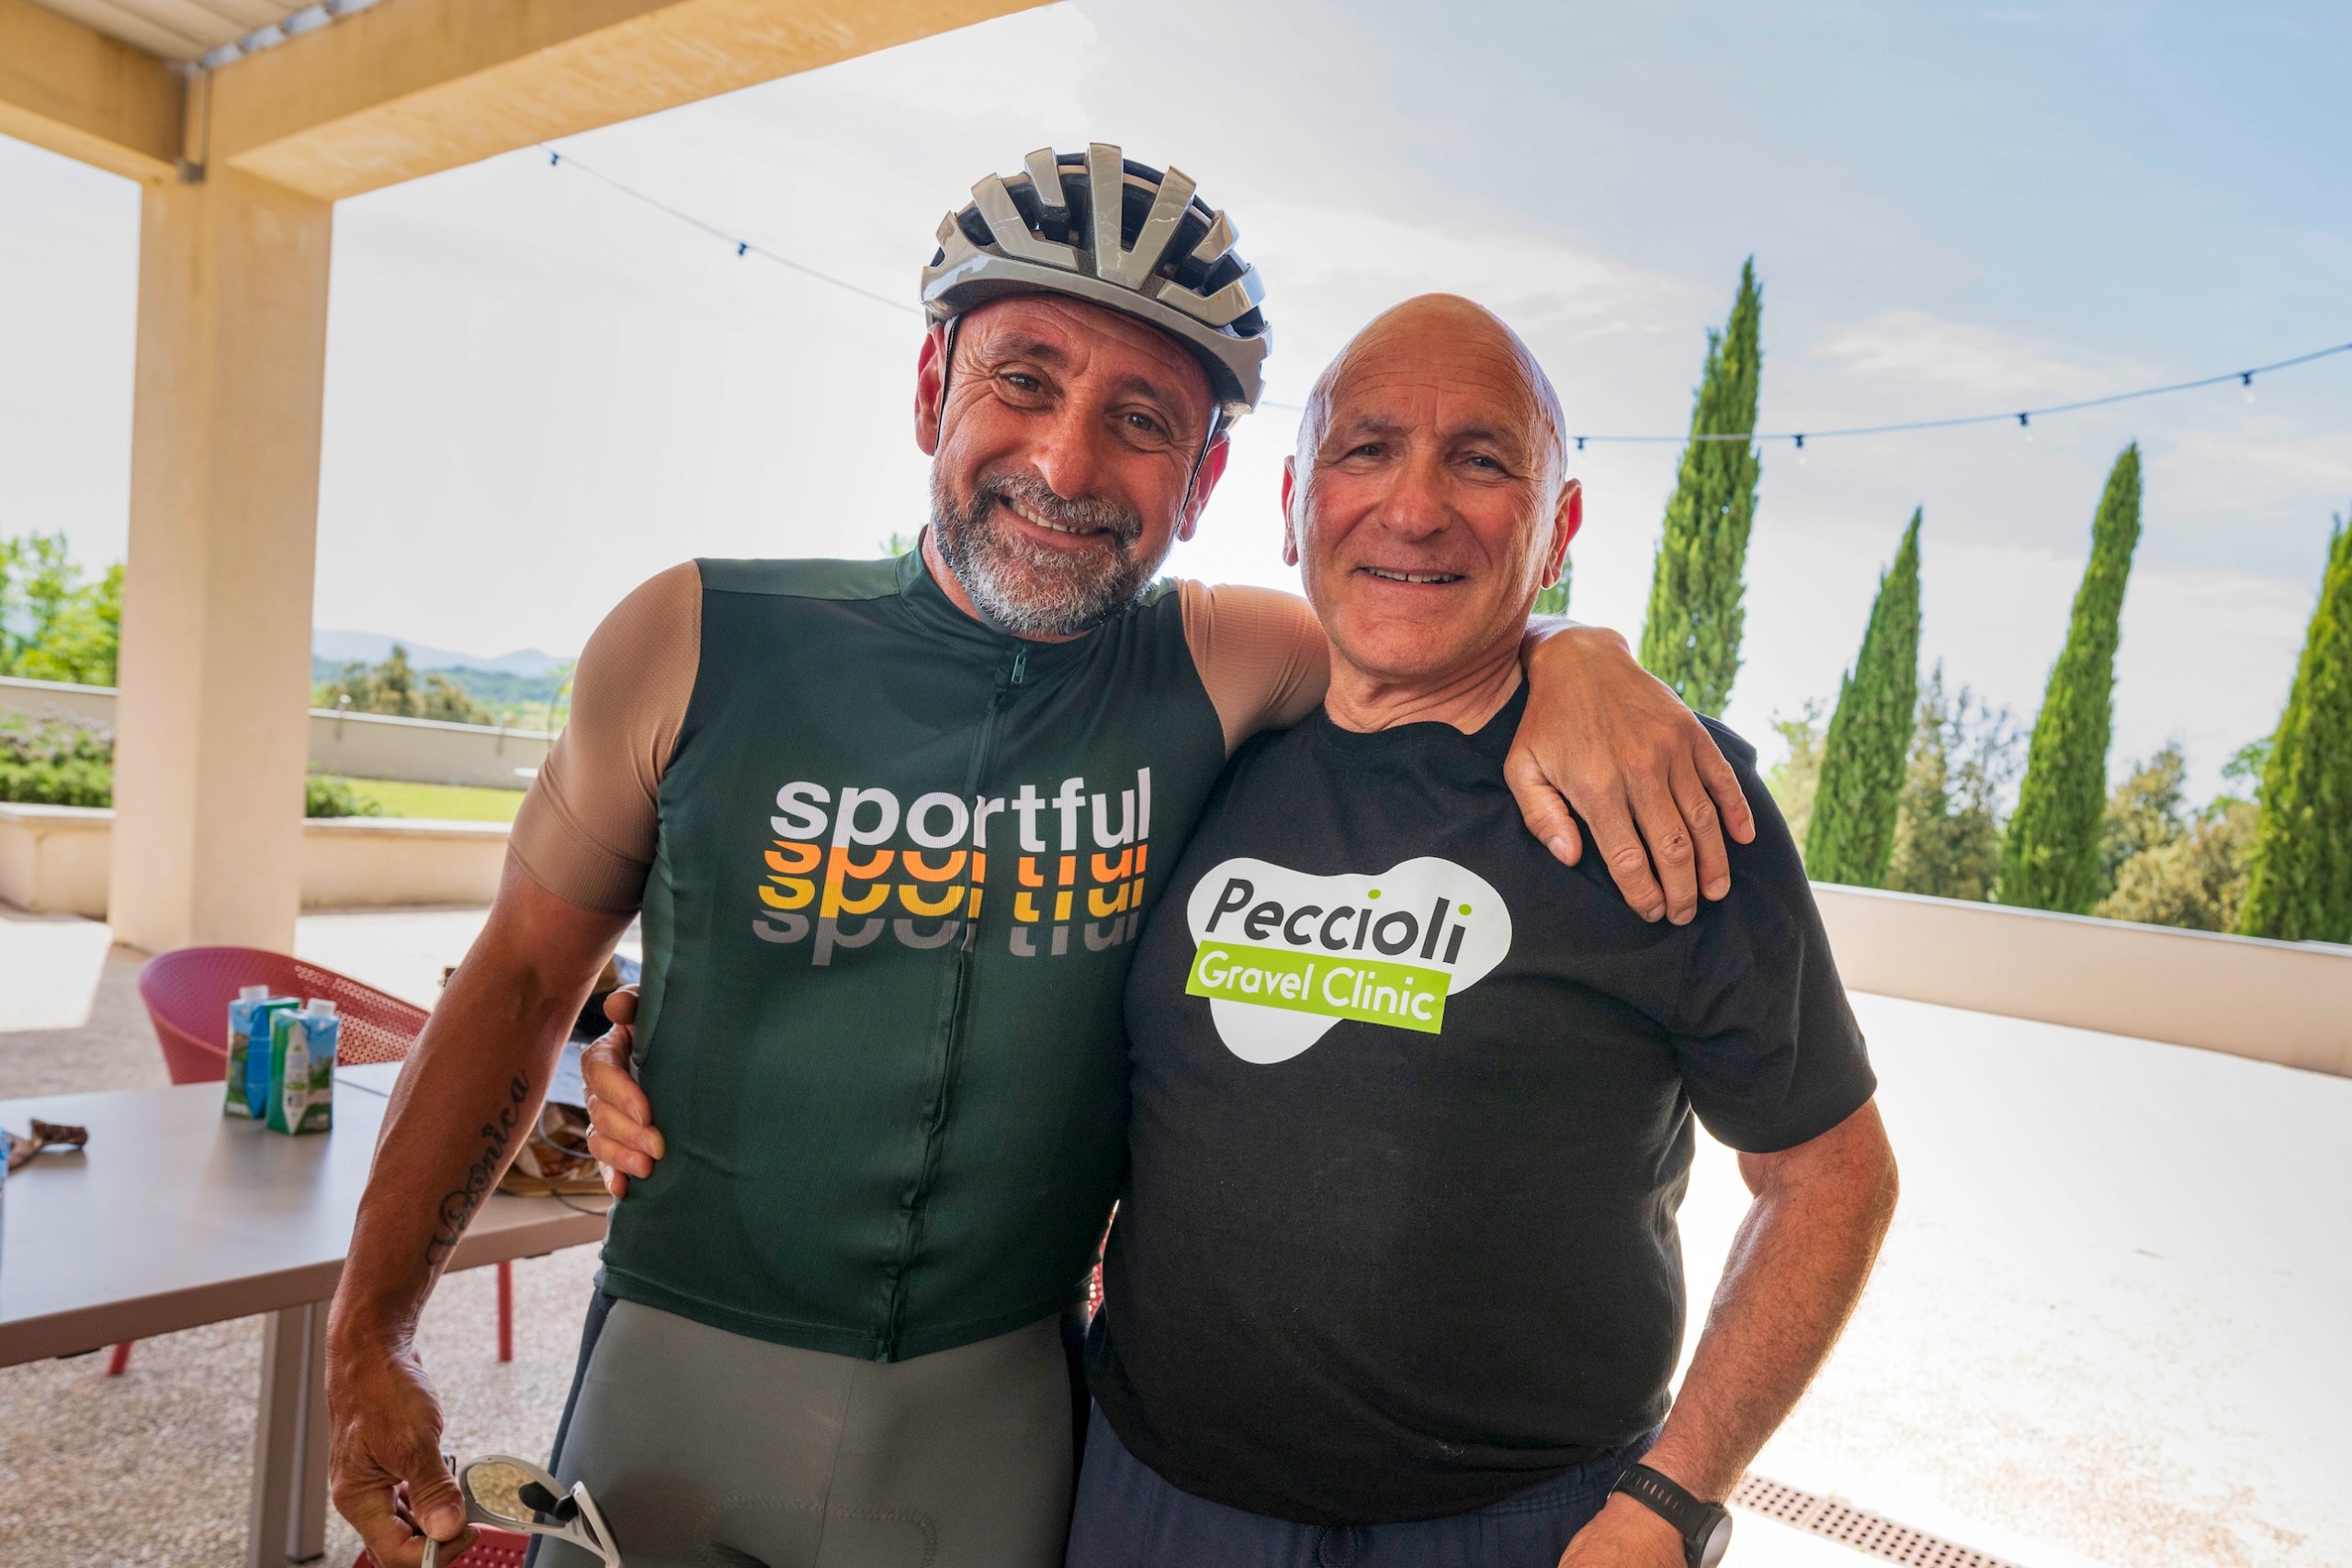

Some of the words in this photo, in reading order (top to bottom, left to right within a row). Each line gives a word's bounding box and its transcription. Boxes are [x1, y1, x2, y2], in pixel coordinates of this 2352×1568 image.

[770, 766, 1151, 877] sportful
[1204, 877, 1473, 964] Peccioli
[1197, 950, 1316, 1000] Gravel
[1322, 966, 1436, 1021] Clinic
